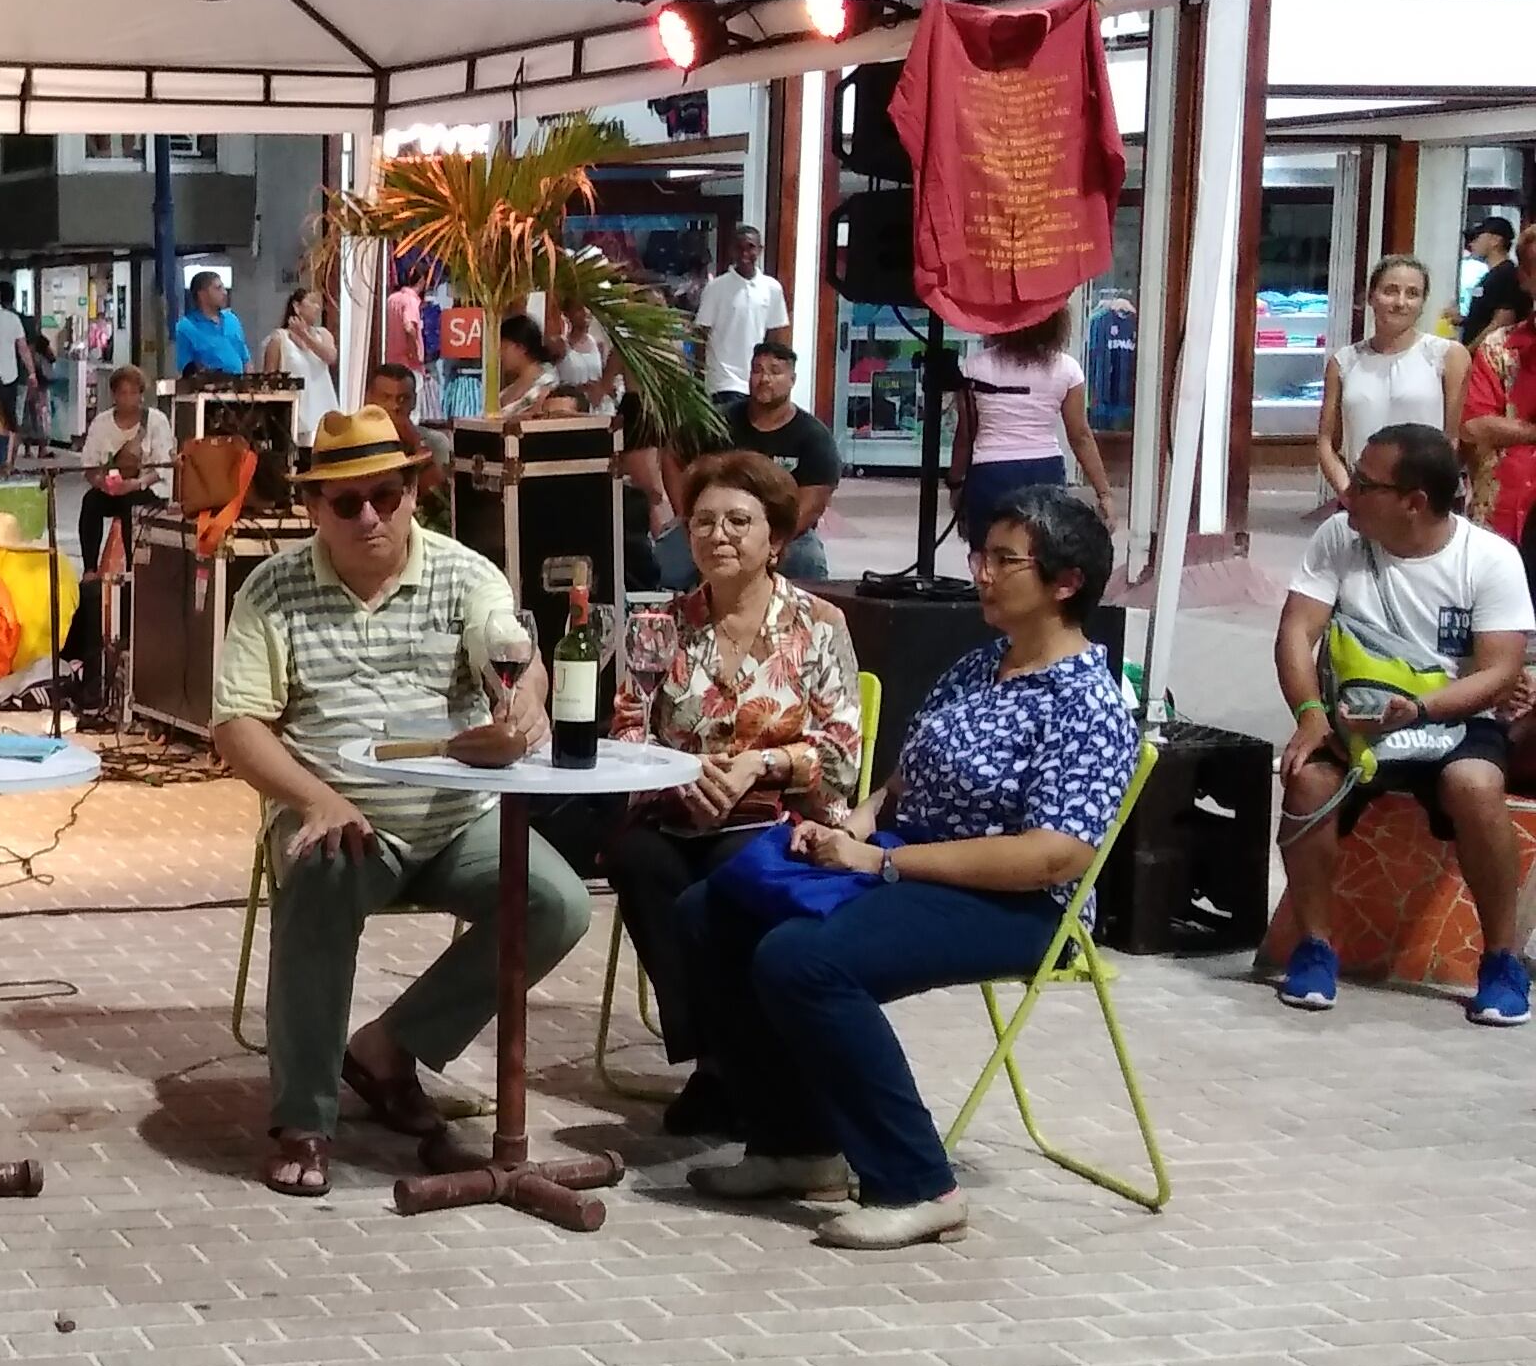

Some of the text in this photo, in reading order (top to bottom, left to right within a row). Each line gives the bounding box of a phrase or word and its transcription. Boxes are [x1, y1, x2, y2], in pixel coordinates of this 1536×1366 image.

[449, 317, 481, 347] SA
[1454, 612, 1470, 629] YO
[1385, 728, 1454, 749] Wilson
